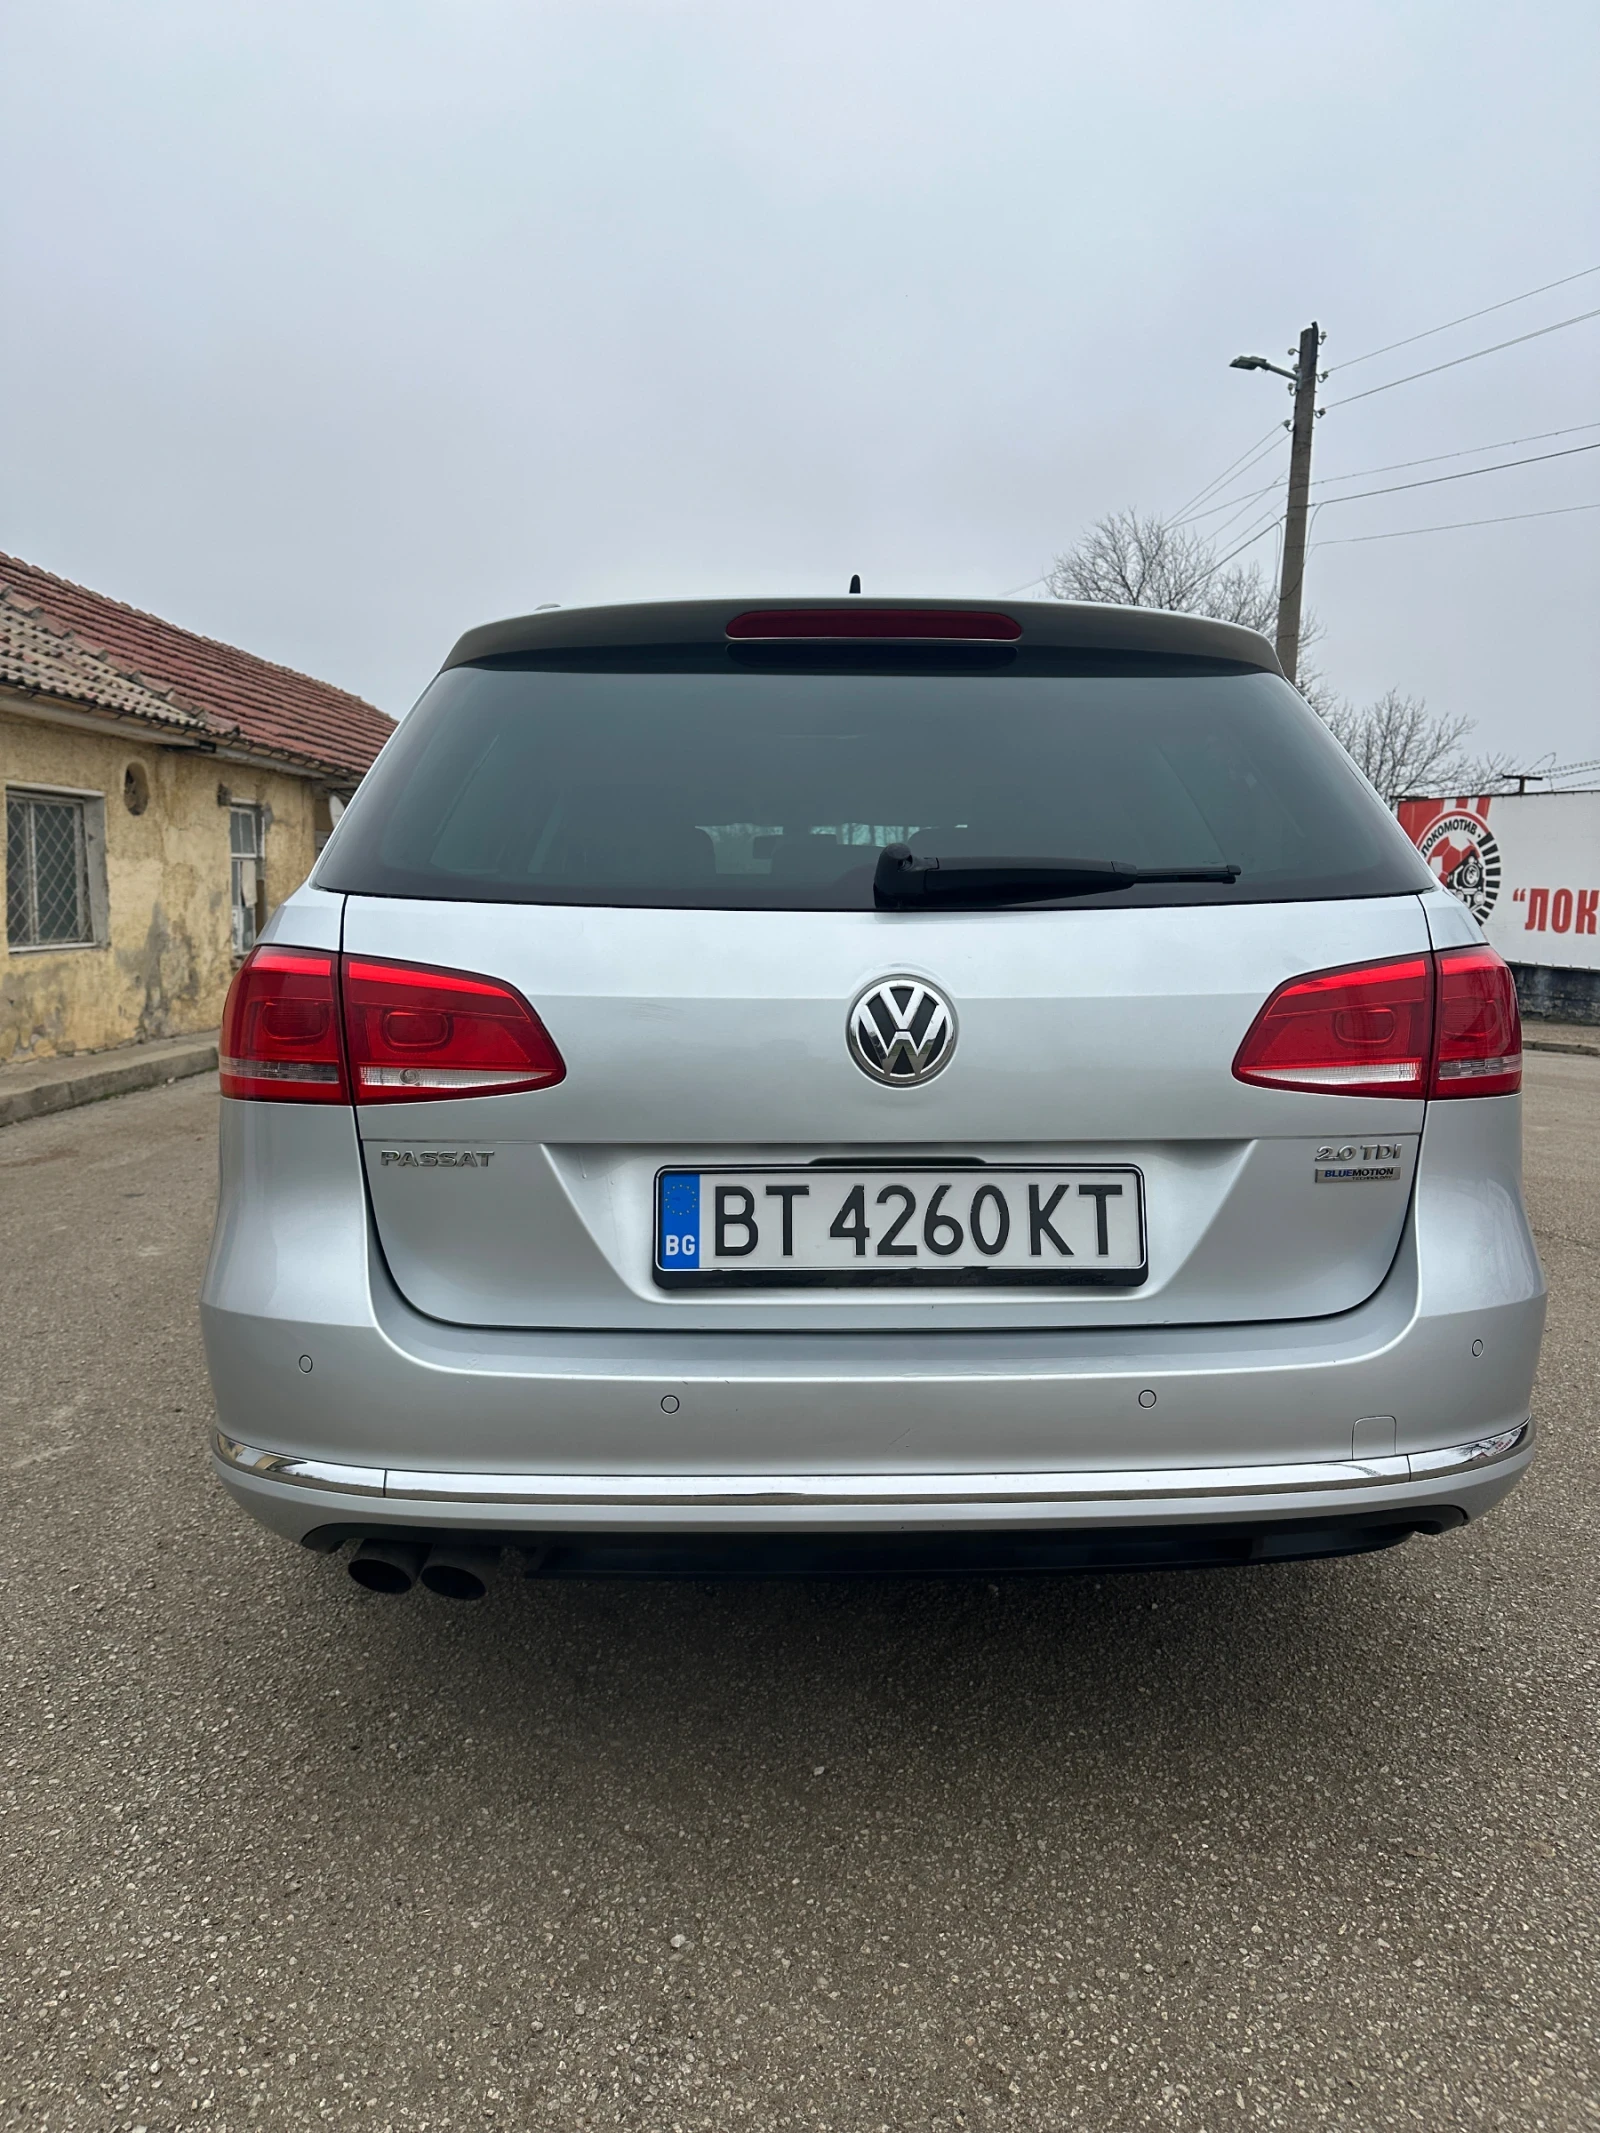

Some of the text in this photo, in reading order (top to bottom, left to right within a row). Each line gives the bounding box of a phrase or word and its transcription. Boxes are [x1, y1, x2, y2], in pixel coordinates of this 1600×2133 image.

[1421, 819, 1478, 858] ЛОКОМОТИВ
[380, 1150, 495, 1167] PASSAT
[1315, 1144, 1402, 1162] 2.0 TDI
[1324, 1168, 1394, 1178] BLUEMOTION
[715, 1184, 1122, 1256] BT 4260 KT
[665, 1234, 696, 1256] BG
